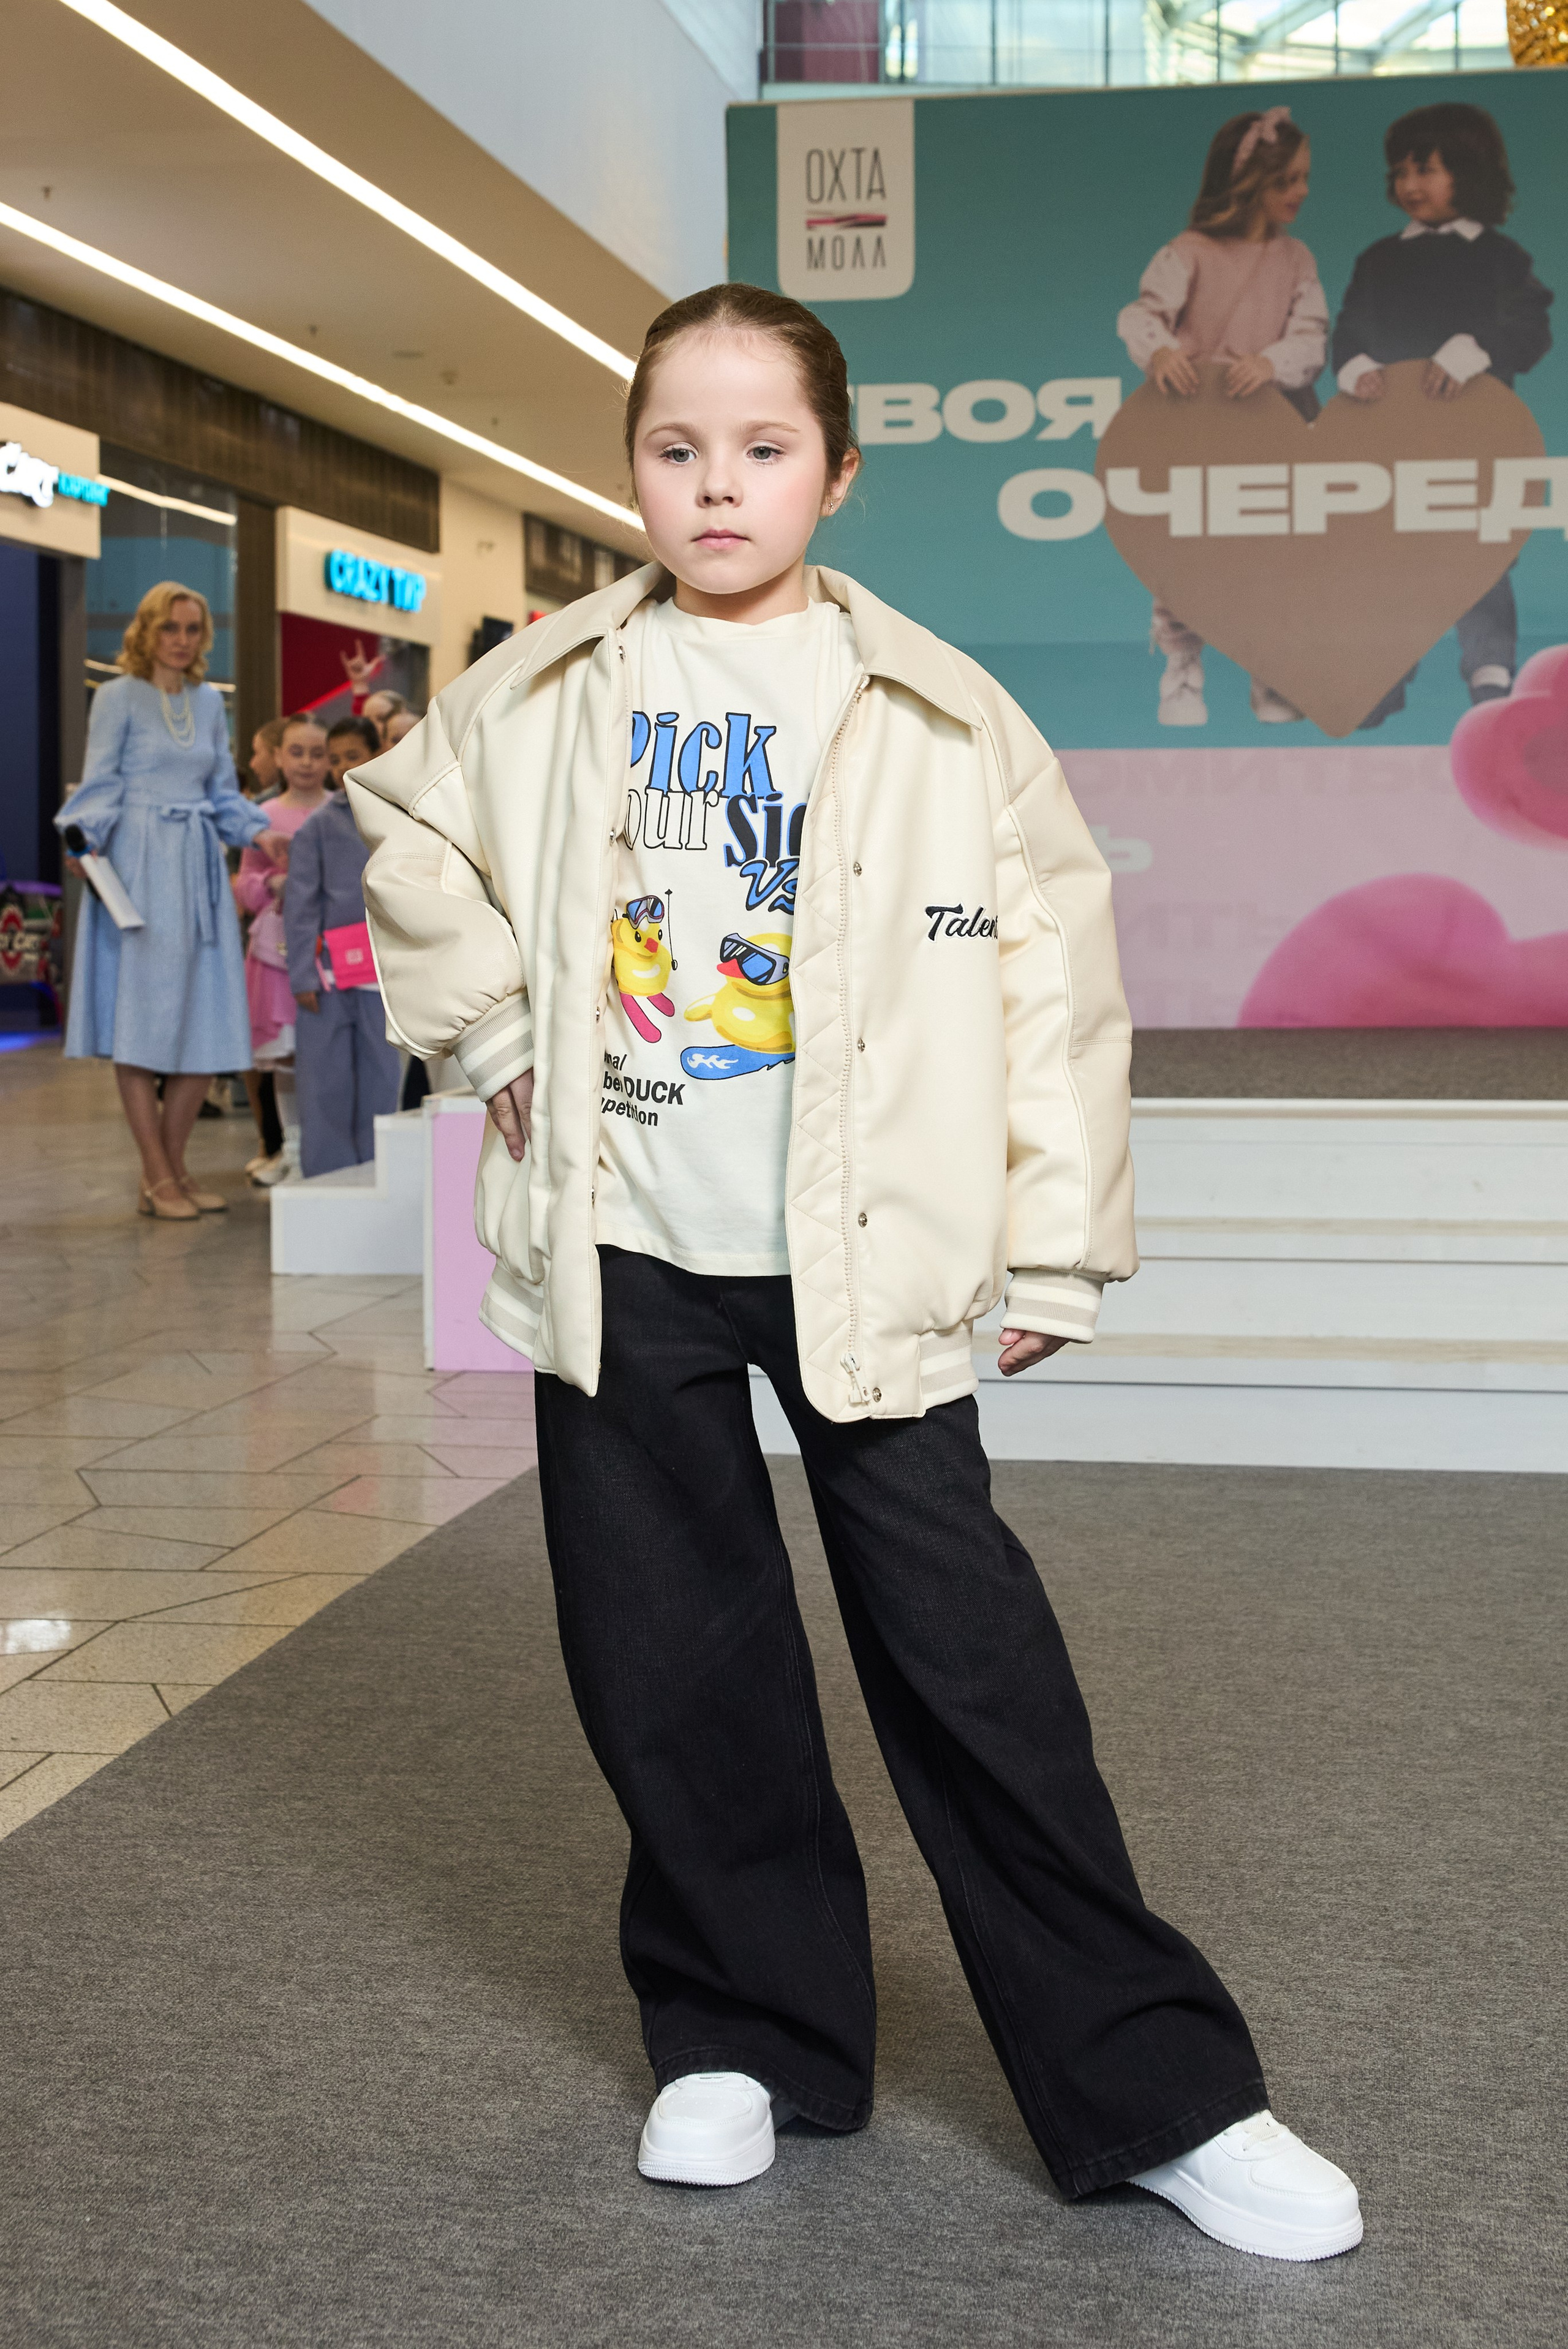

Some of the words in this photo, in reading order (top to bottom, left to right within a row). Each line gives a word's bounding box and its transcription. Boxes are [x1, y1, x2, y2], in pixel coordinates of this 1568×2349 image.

[805, 147, 887, 203] ОХТА
[806, 235, 887, 271] МОЛЛ
[846, 376, 1122, 446] ВОЯ
[624, 1076, 686, 1105] DUCK
